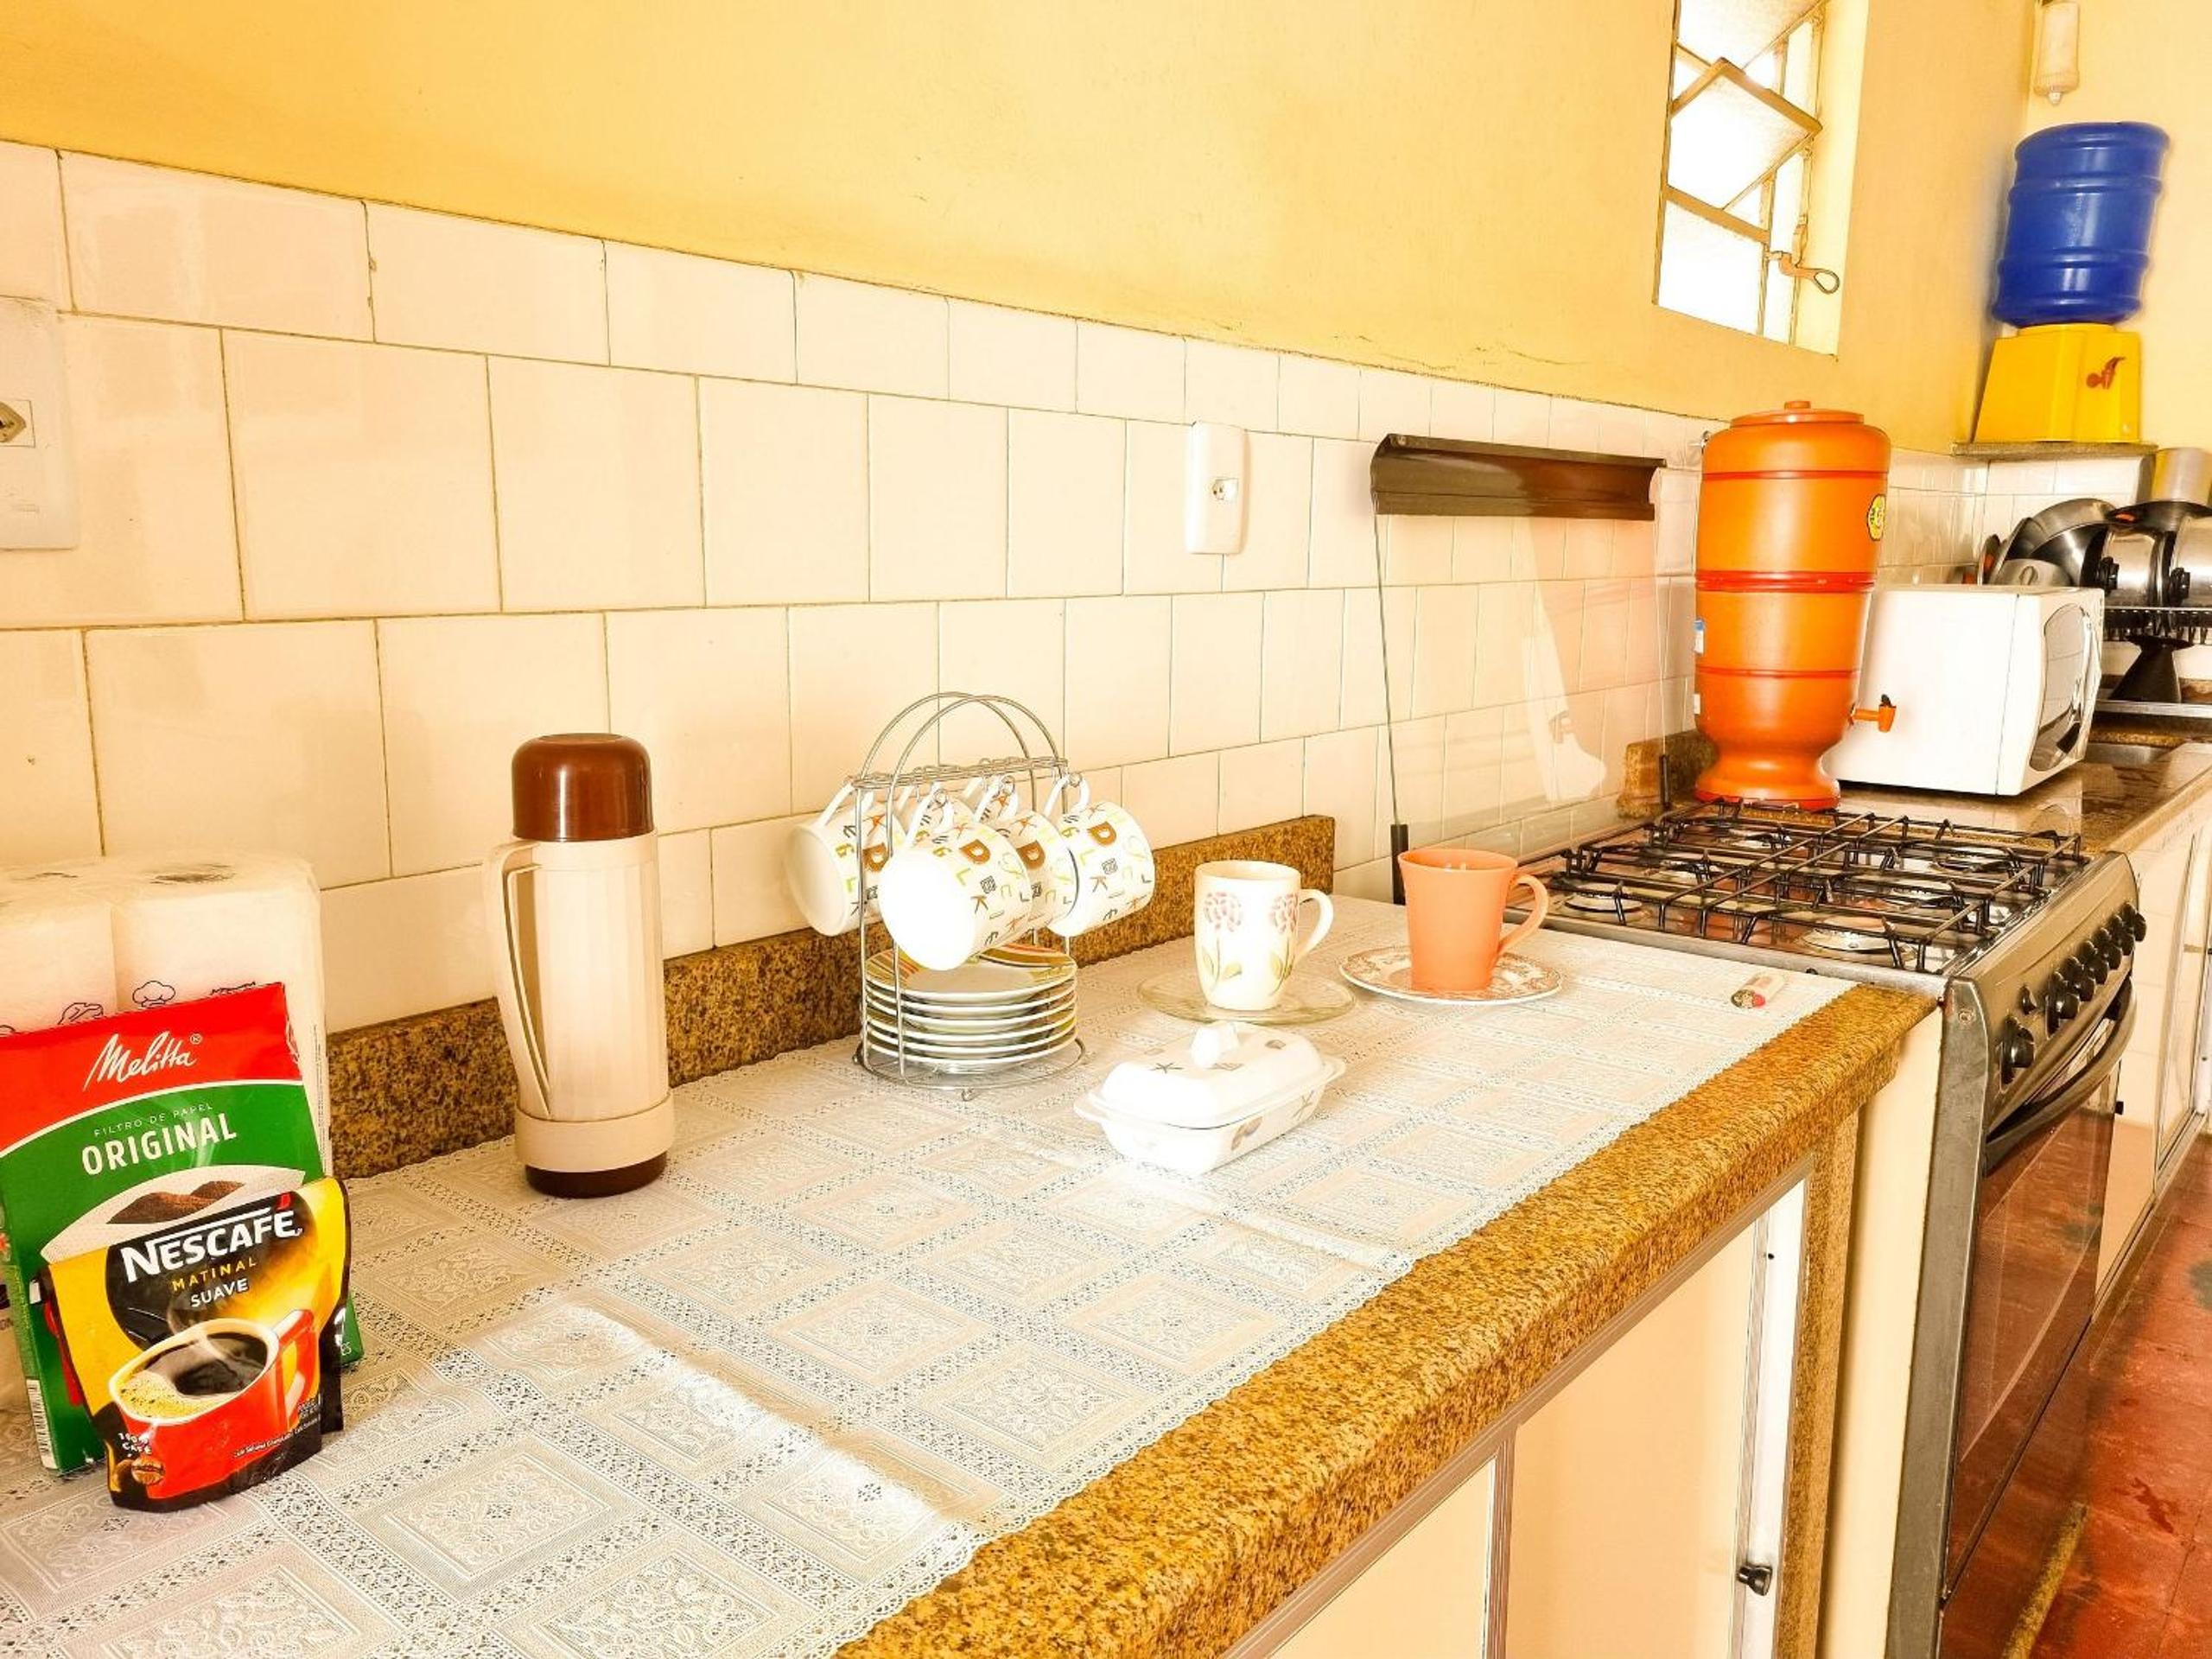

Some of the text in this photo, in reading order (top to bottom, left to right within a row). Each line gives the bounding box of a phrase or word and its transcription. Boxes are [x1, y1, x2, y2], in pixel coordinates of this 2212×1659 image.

[94, 1102, 213, 1137] FILTRO DE PAPEL
[82, 1113, 237, 1175] ORIGINAL
[172, 1255, 257, 1292] MATINAL
[190, 1278, 248, 1307] SUAVE
